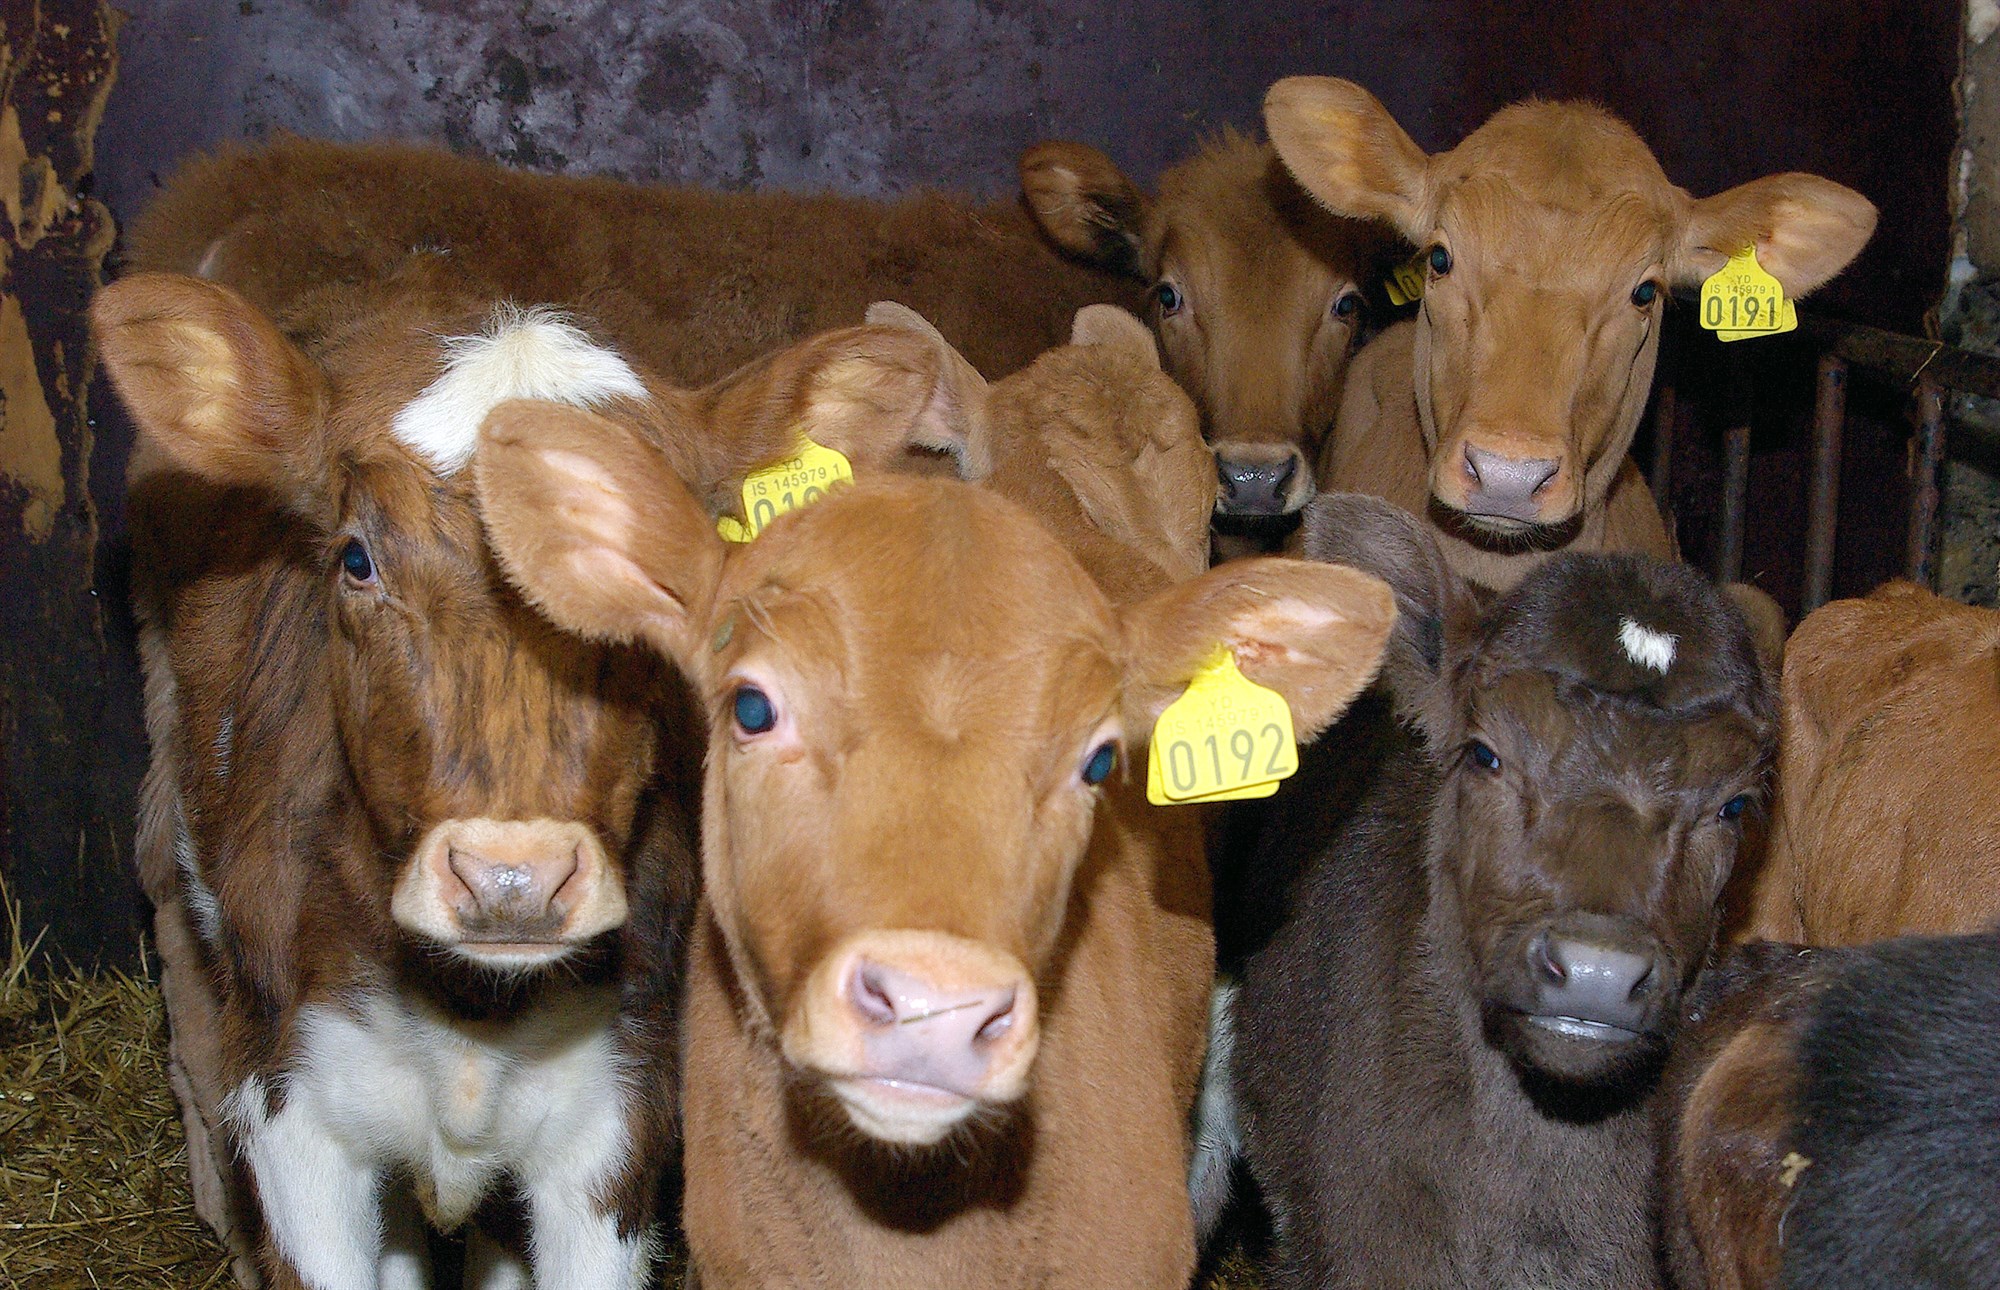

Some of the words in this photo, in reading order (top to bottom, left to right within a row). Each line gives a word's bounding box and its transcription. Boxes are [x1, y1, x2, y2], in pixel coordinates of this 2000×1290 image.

[1736, 274, 1751, 284] YD
[1710, 284, 1721, 294] IS
[1726, 284, 1766, 295] 145979
[1771, 286, 1776, 295] 1
[1706, 295, 1776, 327] 0191
[782, 458, 804, 472] YD
[752, 481, 767, 496] IS
[774, 467, 827, 492] 145979
[833, 463, 840, 476] 1
[1209, 695, 1232, 710] YD
[1169, 722, 1289, 792] 0192
